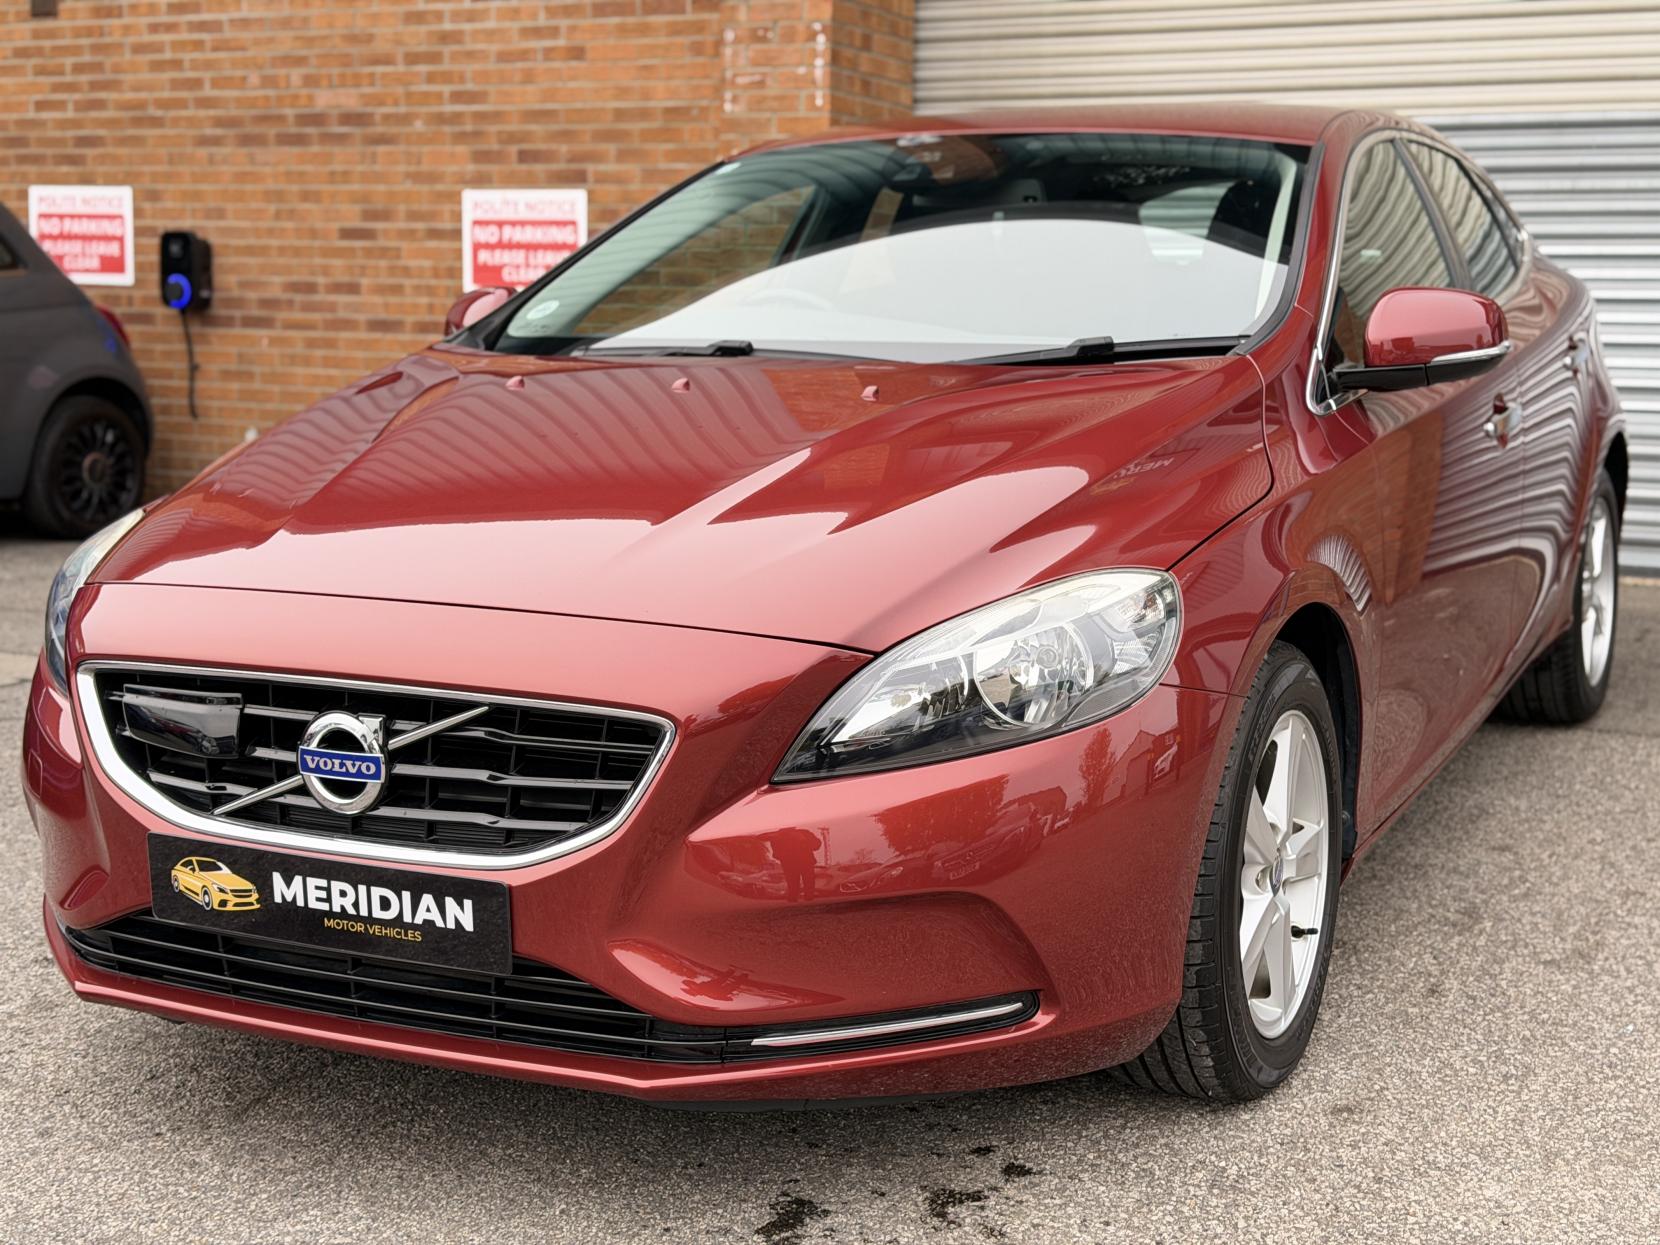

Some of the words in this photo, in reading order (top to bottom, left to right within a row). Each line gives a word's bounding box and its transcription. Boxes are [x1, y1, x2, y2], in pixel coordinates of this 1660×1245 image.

[82, 196, 124, 211] NOTICE
[524, 201, 577, 217] NOTICE
[38, 216, 61, 235] NO
[62, 216, 124, 237] PARKING
[473, 224, 500, 244] NO
[501, 224, 577, 245] PARKING
[84, 239, 121, 257] LEAVE
[477, 247, 526, 267] PLEASE
[303, 754, 376, 776] VOLVO
[271, 871, 475, 933] MERIDIAN
[324, 917, 365, 934] MOTOR
[366, 923, 423, 942] VEHICLES
